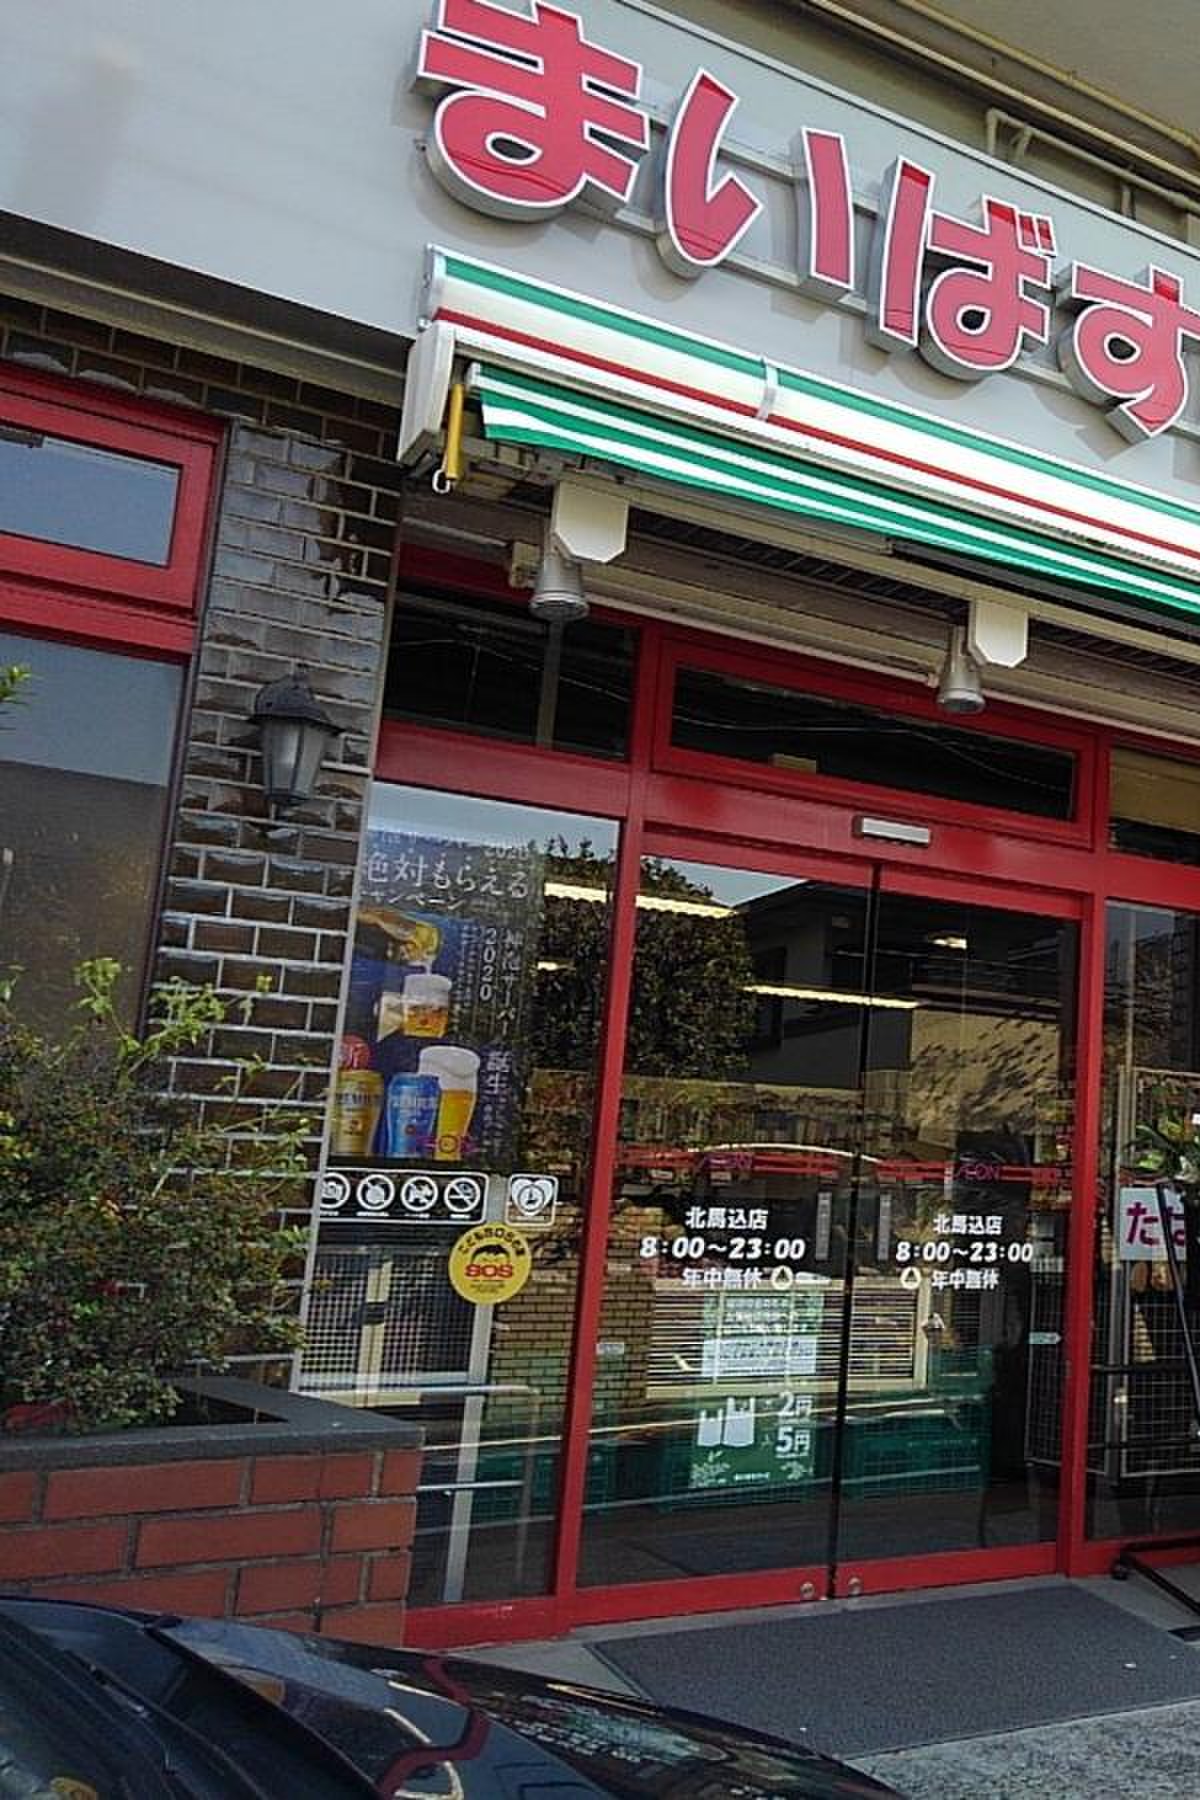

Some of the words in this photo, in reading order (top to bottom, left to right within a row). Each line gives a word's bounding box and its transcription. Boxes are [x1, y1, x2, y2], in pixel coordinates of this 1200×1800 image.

[479, 927, 498, 1002] 2020
[685, 1206, 769, 1230] 北馬込店
[933, 1214, 1003, 1236] 北馬込店
[463, 1263, 514, 1278] SOS
[681, 1267, 764, 1289] 年中無休
[931, 1268, 1001, 1290] 年中無休
[775, 1425, 812, 1454] 5円
